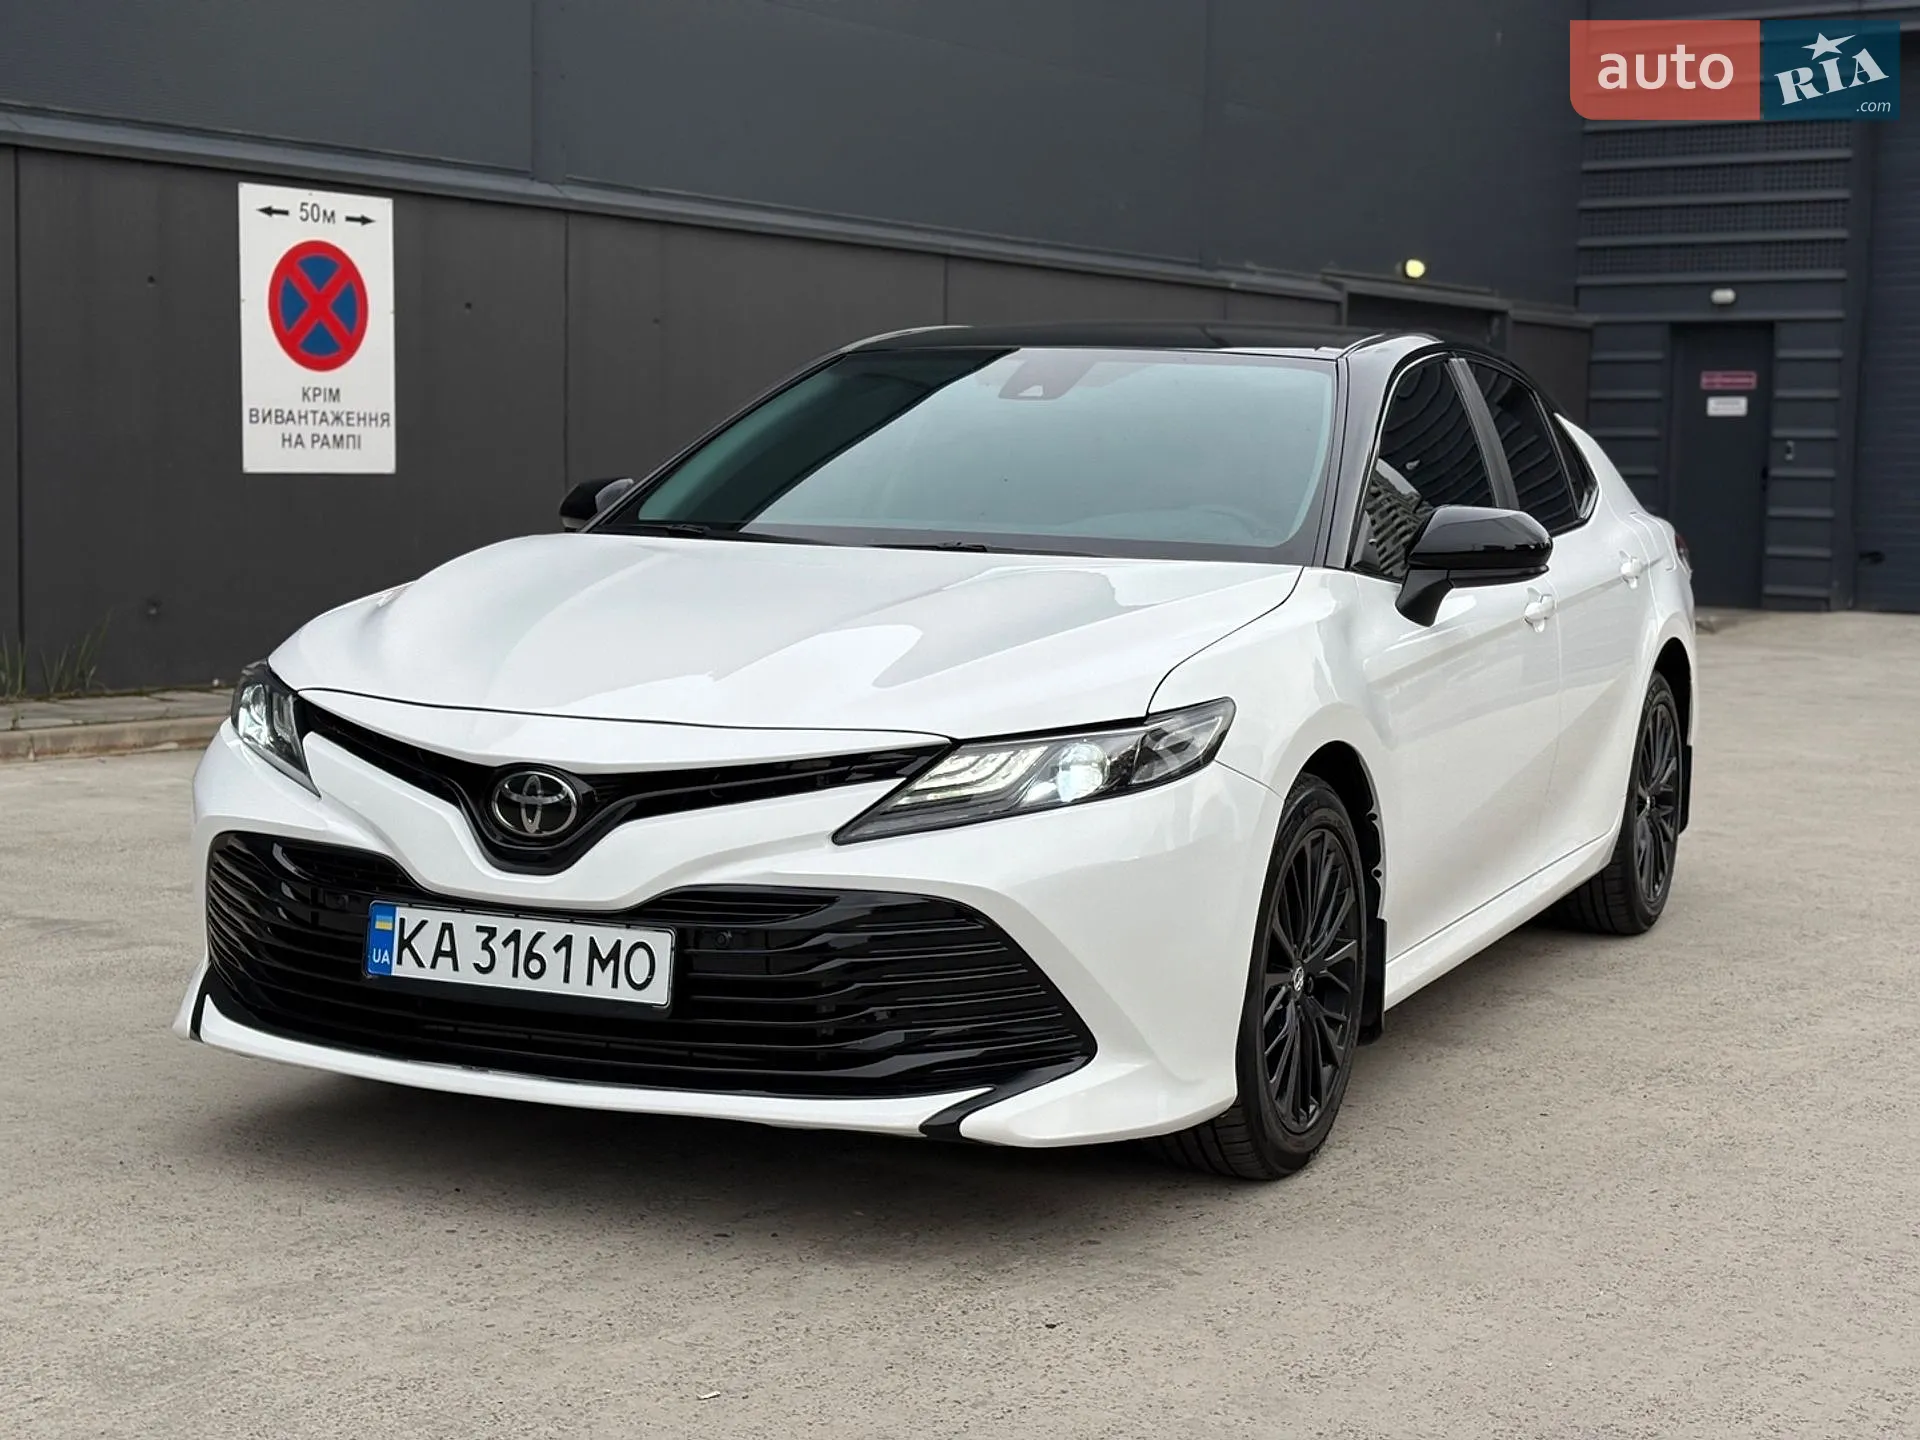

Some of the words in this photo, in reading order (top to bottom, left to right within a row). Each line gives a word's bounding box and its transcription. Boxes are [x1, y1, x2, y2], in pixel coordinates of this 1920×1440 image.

[301, 386, 341, 402] КРІМ
[248, 407, 391, 428] ВИВАНТАЖЕННЯ
[281, 432, 305, 449] НА
[310, 433, 362, 450] РАМПІ
[372, 949, 391, 966] UA
[396, 917, 459, 972] KA
[472, 925, 574, 984] 3161
[586, 935, 656, 991] MO
